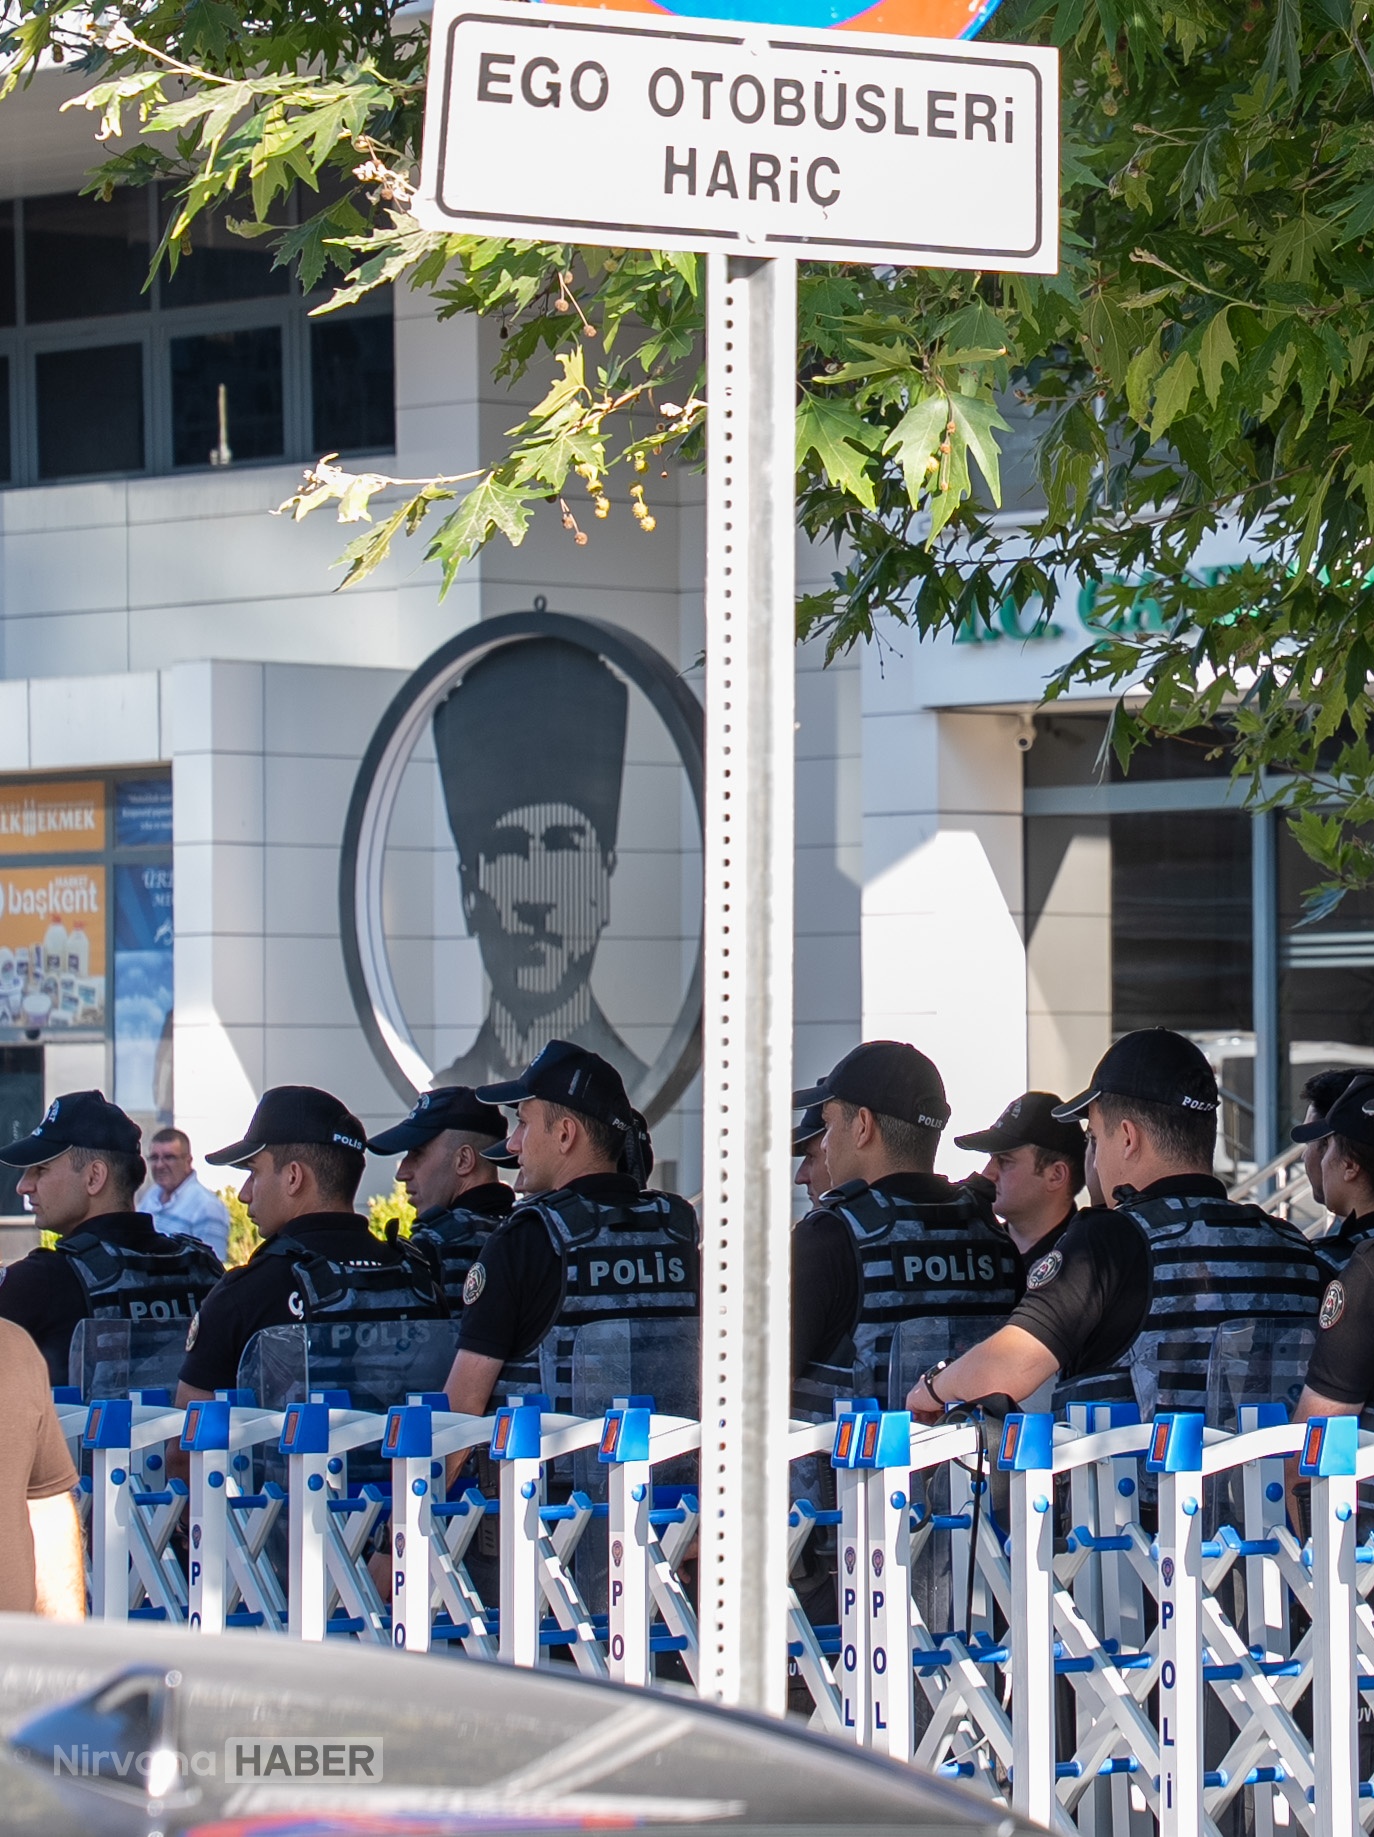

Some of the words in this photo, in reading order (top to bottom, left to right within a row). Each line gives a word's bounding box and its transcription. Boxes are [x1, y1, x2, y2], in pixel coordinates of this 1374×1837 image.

[477, 52, 610, 112] EGO
[38, 808, 96, 832] EKMEK
[9, 878, 99, 921] başkent
[590, 1251, 685, 1287] POLİS
[903, 1248, 995, 1282] POLİS
